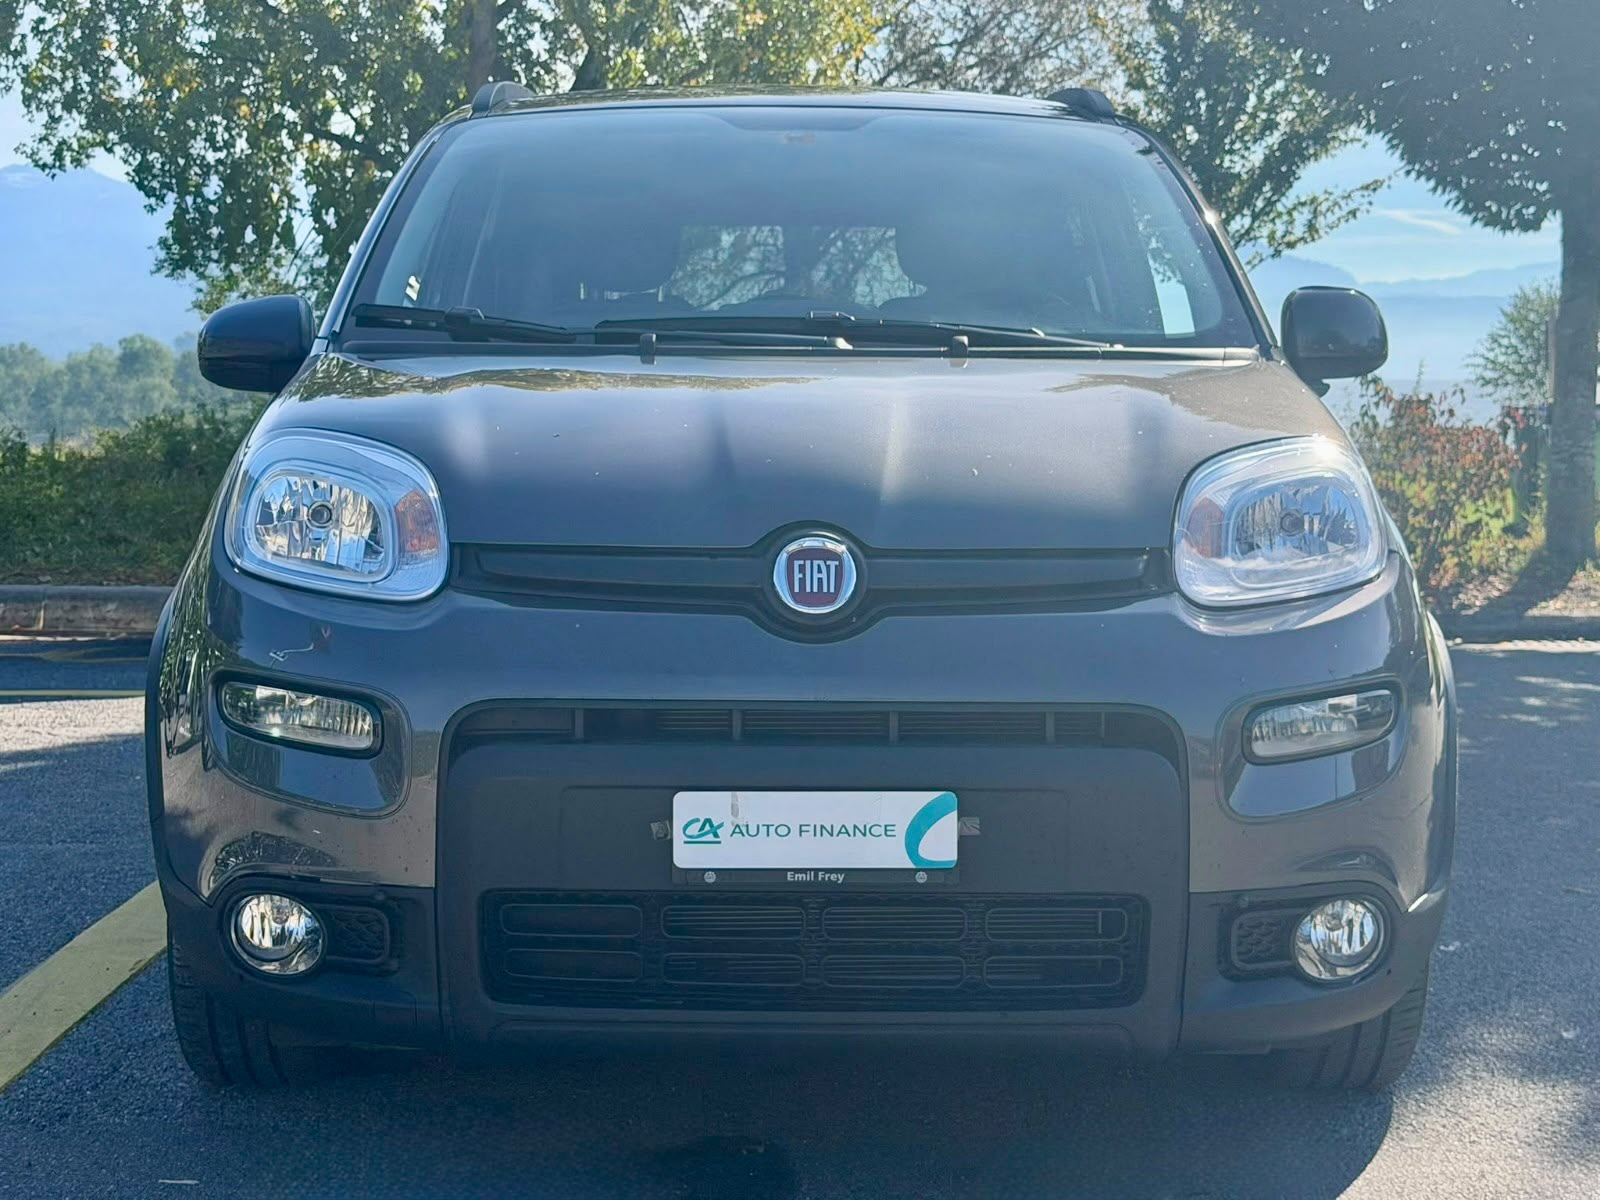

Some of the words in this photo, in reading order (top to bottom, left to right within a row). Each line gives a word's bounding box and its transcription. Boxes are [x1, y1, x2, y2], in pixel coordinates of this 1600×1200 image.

[793, 560, 839, 593] FIAT
[730, 823, 791, 838] AUTO
[799, 823, 896, 838] FINANCE
[787, 871, 815, 882] Emil
[818, 872, 845, 884] Frey
